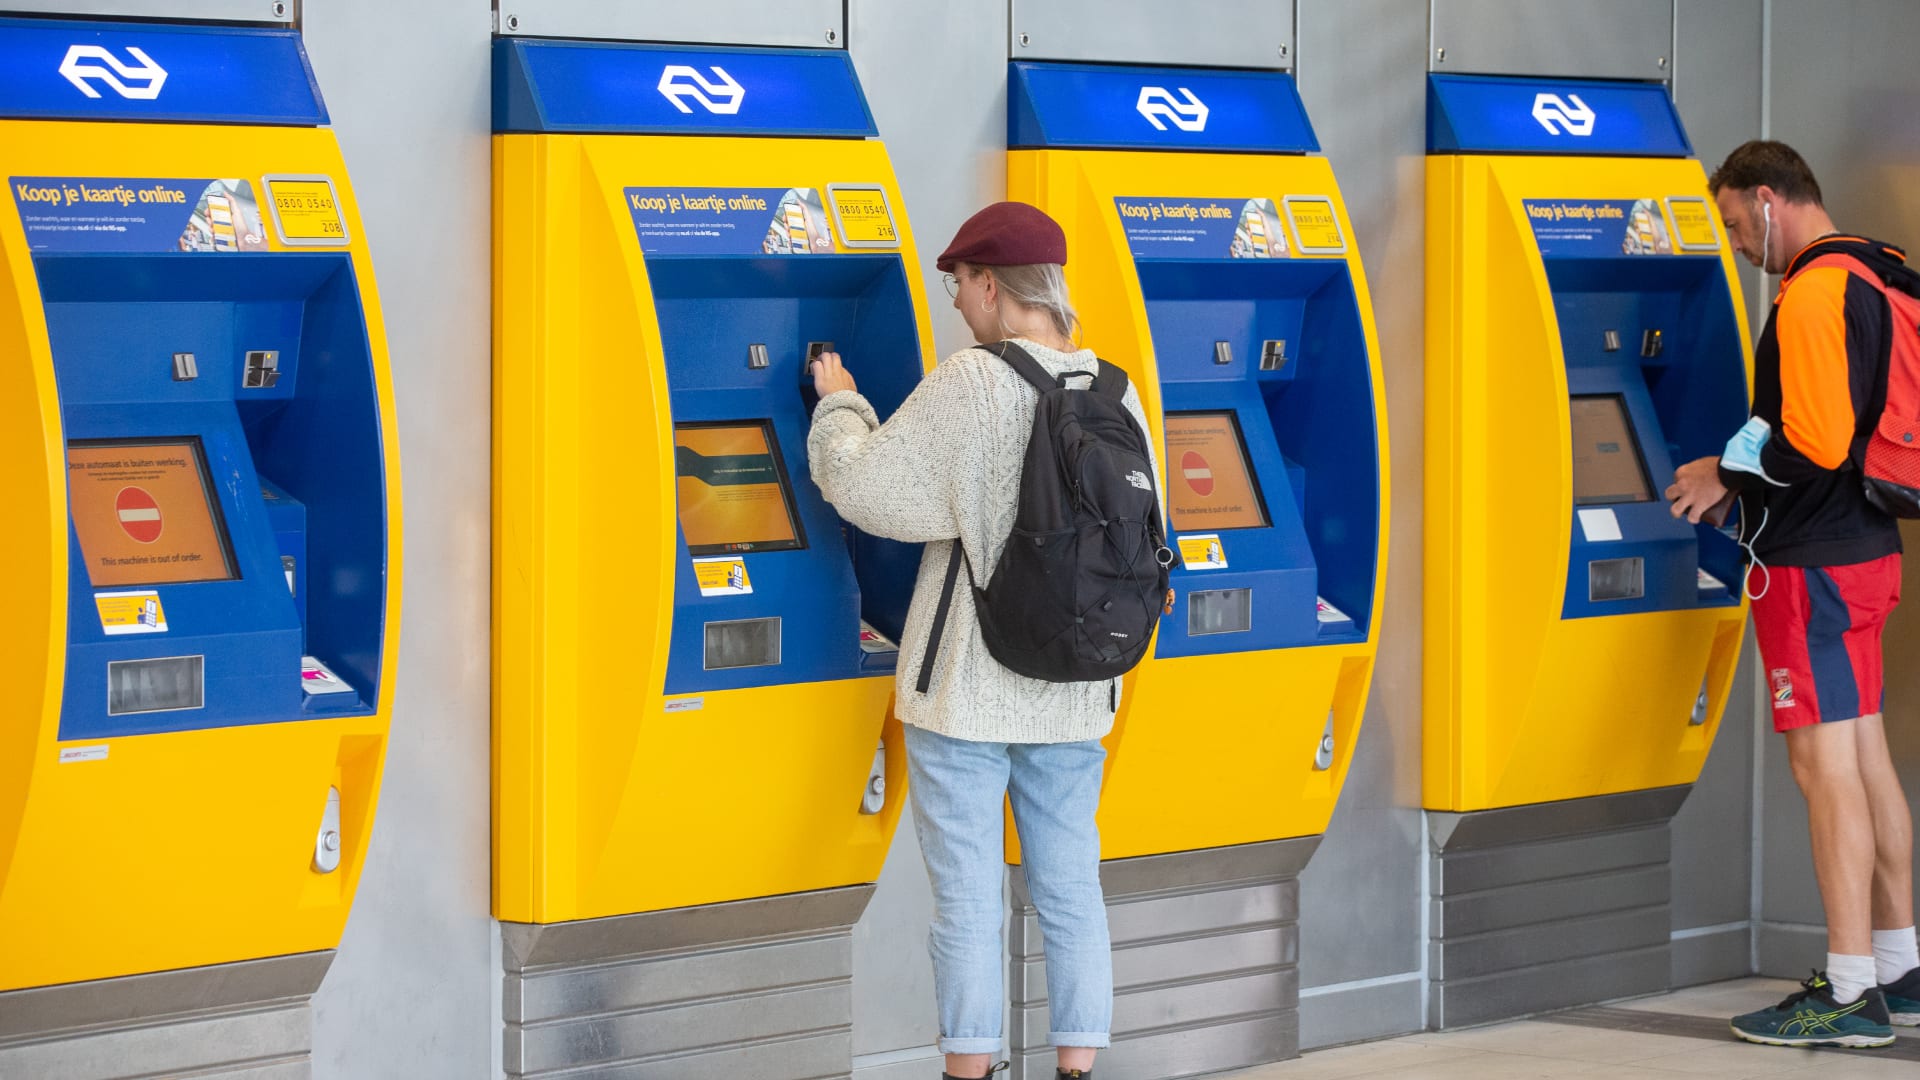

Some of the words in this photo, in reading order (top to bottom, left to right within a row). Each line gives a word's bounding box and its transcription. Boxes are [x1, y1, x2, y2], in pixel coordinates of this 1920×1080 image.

[17, 183, 62, 207] Koop
[62, 184, 80, 207] je
[80, 183, 137, 207] kaartje
[138, 185, 187, 204] online
[277, 198, 303, 209] 0800
[306, 198, 332, 209] 0540
[630, 193, 667, 214] Koop
[667, 194, 681, 214] je
[681, 193, 727, 214] kaartje
[728, 194, 768, 211] online
[839, 205, 861, 215] 0800
[864, 205, 885, 215] 0540
[1119, 202, 1150, 221] Koop
[1149, 203, 1162, 221] je
[1160, 202, 1199, 222] kaartje
[1200, 204, 1233, 219] online
[1526, 204, 1553, 221] Koop
[322, 222, 342, 233] 208
[877, 227, 893, 237] 216
[101, 556, 117, 566] This
[118, 555, 149, 565] machine
[150, 554, 157, 563] is
[158, 554, 171, 563] out
[172, 552, 180, 562] of
